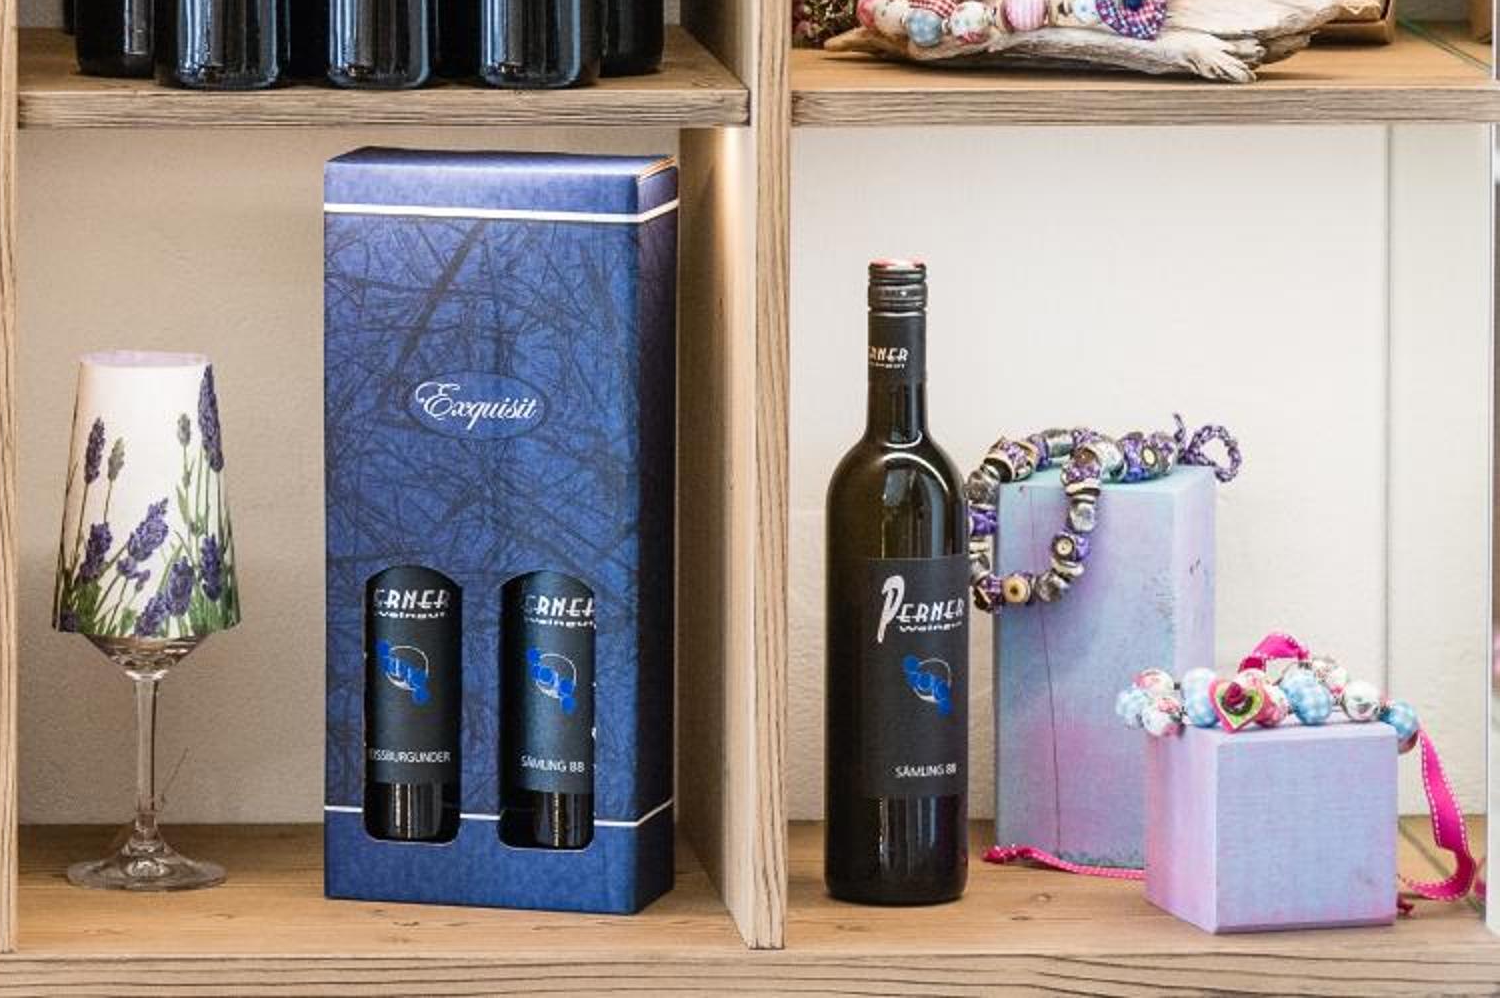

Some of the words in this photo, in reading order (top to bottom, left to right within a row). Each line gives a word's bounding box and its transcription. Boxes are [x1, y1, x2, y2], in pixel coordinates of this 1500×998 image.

[416, 382, 537, 431] Exquisit
[877, 575, 965, 643] PERNER
[521, 755, 566, 772] SÄMLING
[569, 759, 585, 773] 88
[895, 764, 944, 779] SÄMLING
[945, 763, 957, 775] 88
